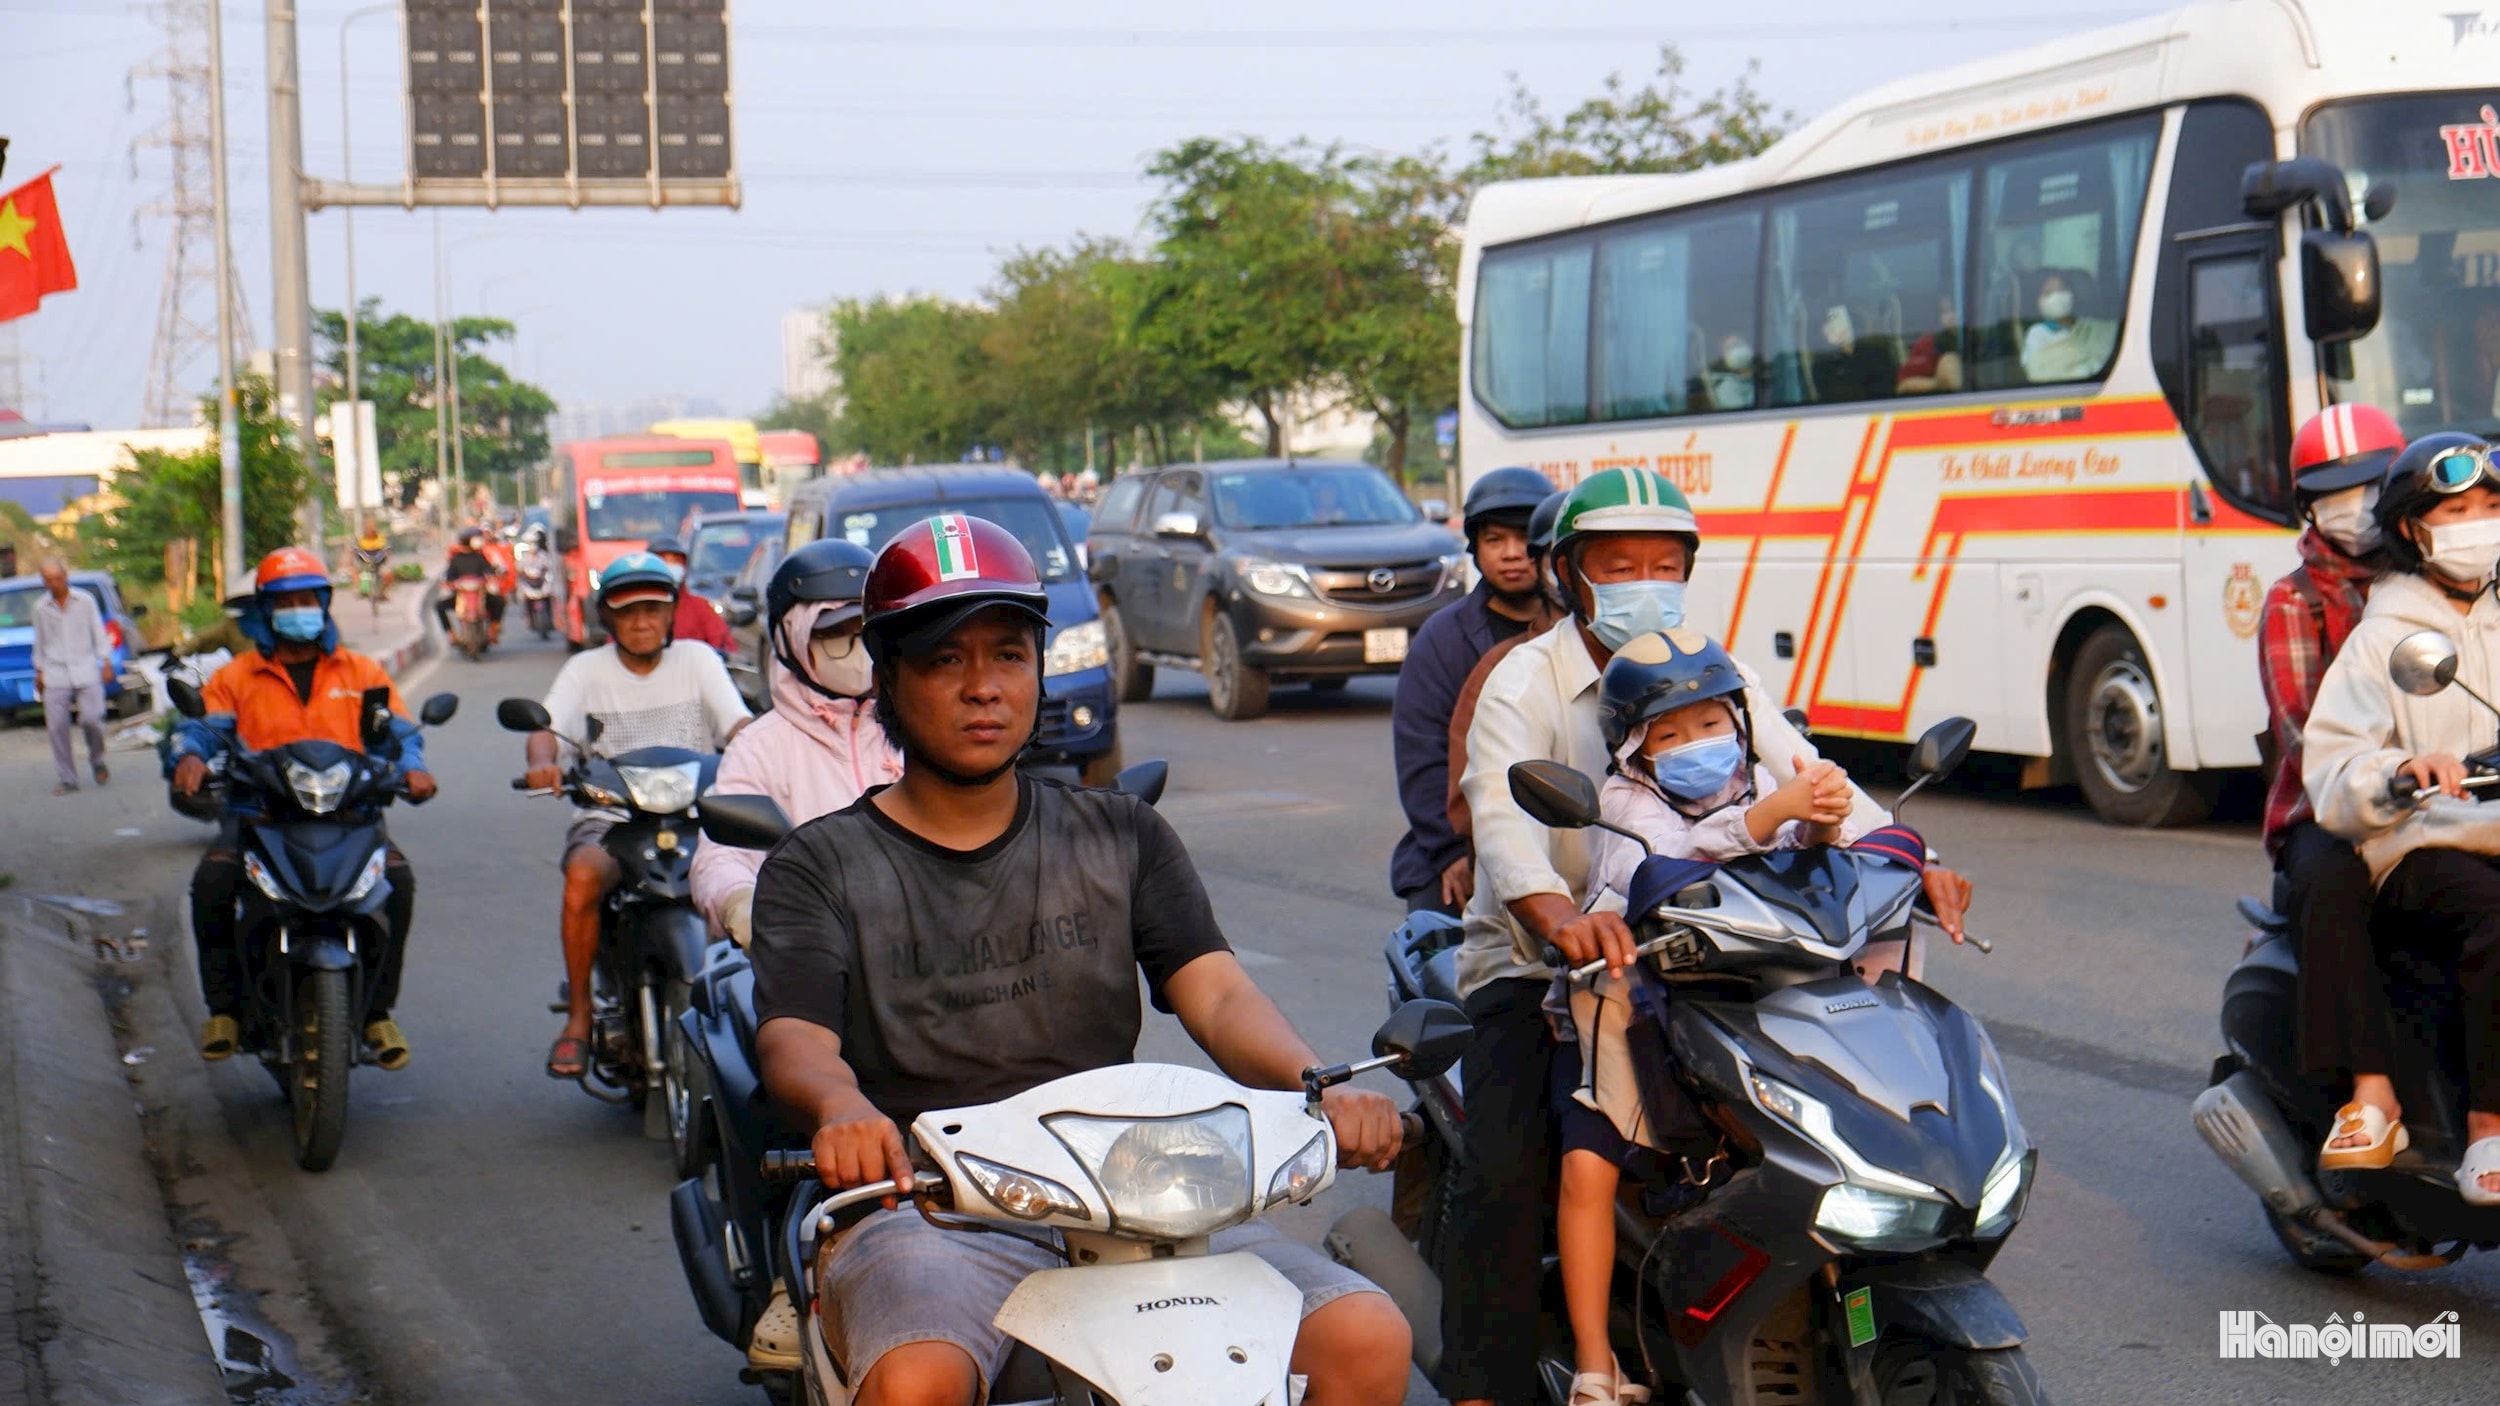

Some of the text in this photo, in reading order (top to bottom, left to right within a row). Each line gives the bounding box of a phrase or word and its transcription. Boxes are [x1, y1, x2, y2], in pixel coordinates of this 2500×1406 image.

[982, 969, 1058, 1005] CHANE
[1826, 998, 1879, 1014] HONDA
[1135, 1296, 1222, 1313] HONDA
